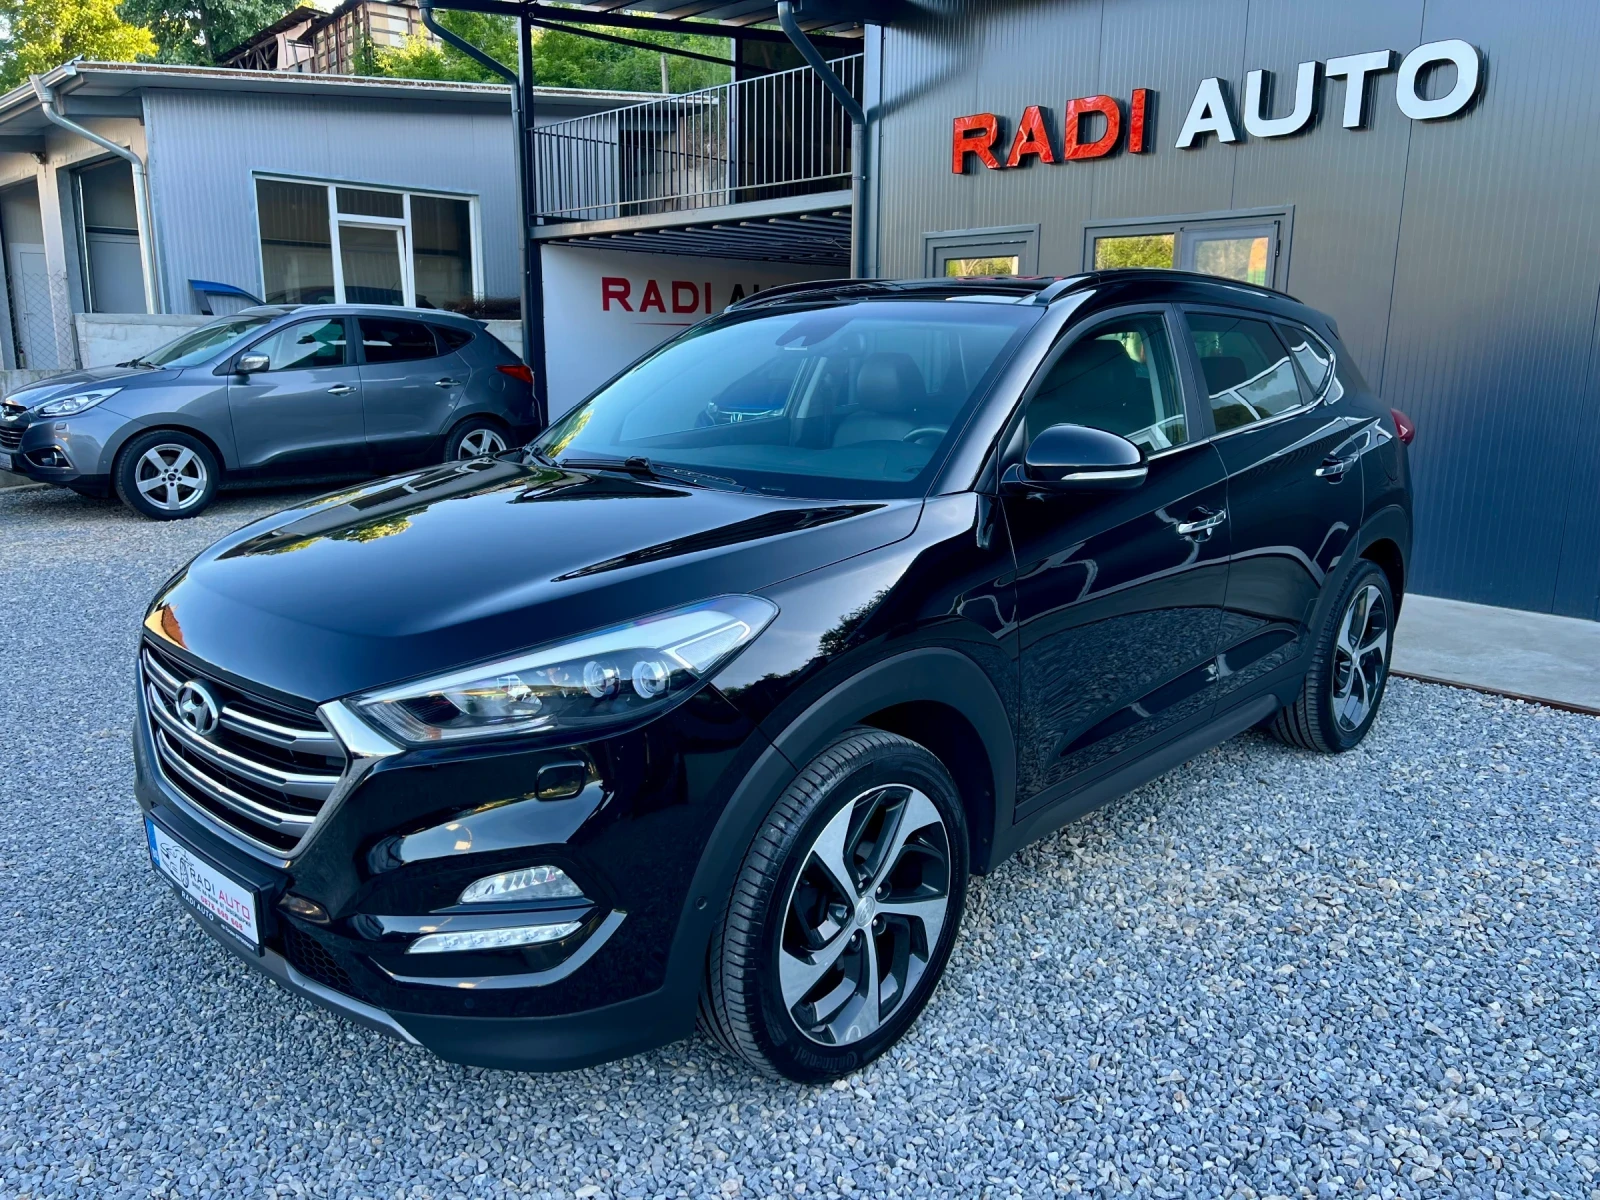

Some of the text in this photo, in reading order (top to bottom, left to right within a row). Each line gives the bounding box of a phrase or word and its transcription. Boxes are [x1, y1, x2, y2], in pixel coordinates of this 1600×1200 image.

[952, 38, 1482, 174] RADI AUTO
[601, 277, 711, 314] RADI
[181, 890, 214, 921] RADI AUTO
[190, 867, 215, 895] RADI
[219, 890, 250, 920] AUTO
[792, 1046, 858, 1073] Continental
